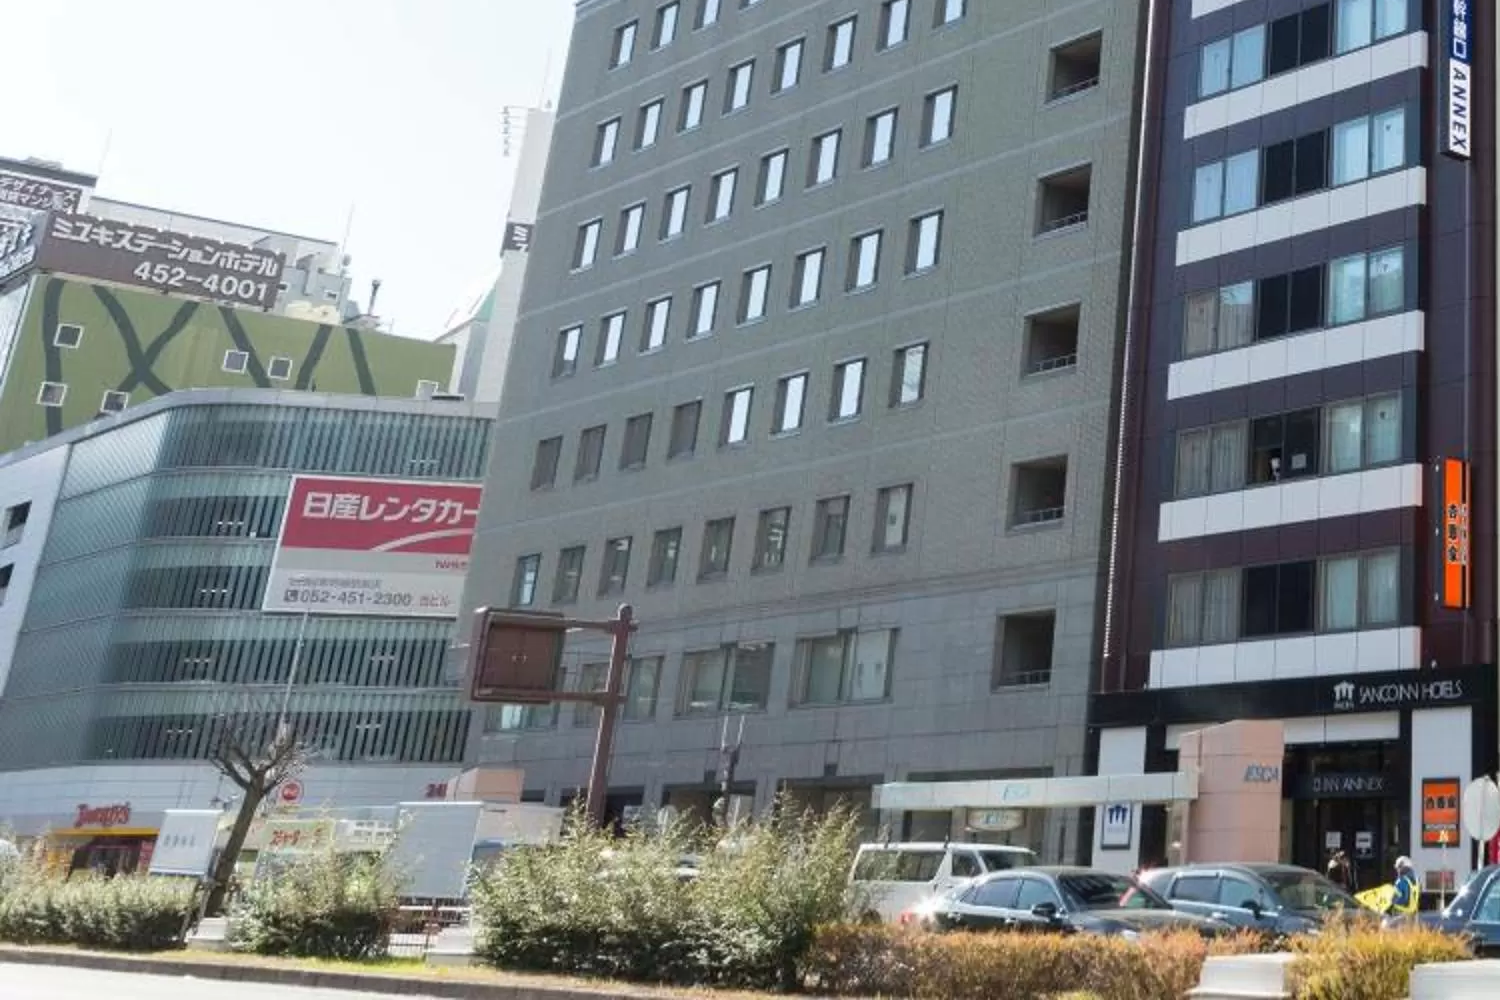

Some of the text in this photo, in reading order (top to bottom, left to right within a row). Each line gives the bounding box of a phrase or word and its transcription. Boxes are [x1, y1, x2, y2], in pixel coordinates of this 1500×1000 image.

[1452, 66, 1468, 151] ANNEX
[133, 262, 268, 301] 452-4001
[303, 492, 480, 524] 日産レンタカー
[1422, 680, 1462, 699] HOTELS
